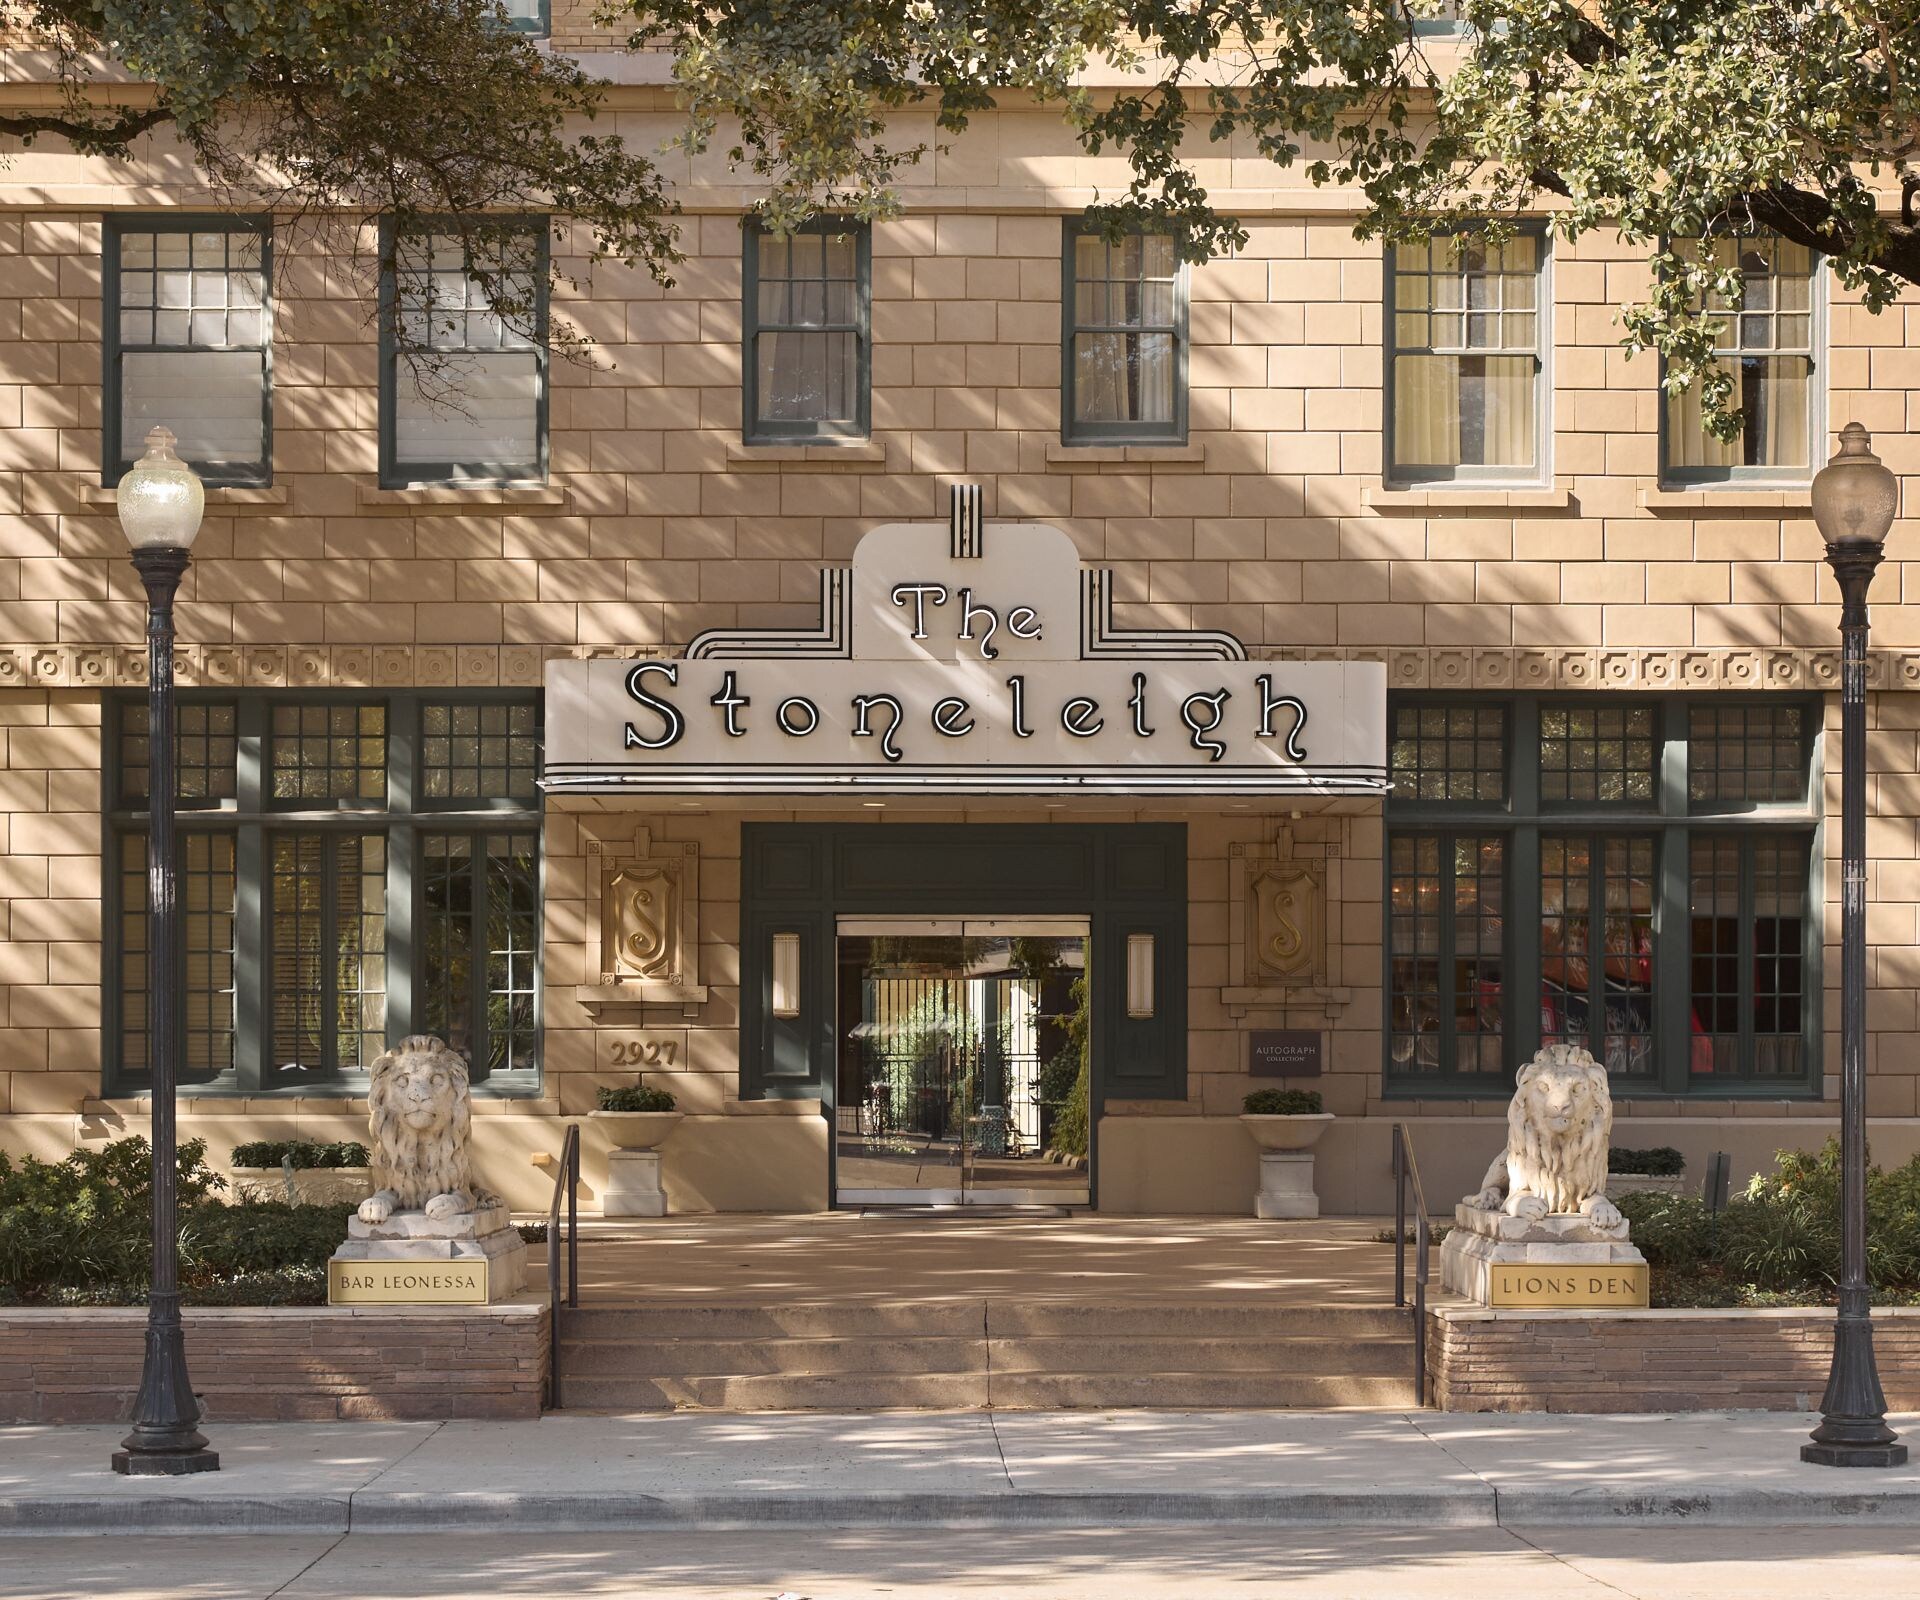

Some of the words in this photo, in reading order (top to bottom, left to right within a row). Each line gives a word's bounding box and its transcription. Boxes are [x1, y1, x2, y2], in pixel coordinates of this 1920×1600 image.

[890, 583, 1043, 659] The
[624, 662, 1307, 762] Stoneleigh
[610, 1040, 678, 1066] 2927
[1256, 1046, 1316, 1055] AUTOGRAPH
[341, 1276, 375, 1289] BAR
[383, 1275, 476, 1289] LEONESSA
[1503, 1277, 1576, 1294] LIONS
[1589, 1278, 1637, 1294] DEN
